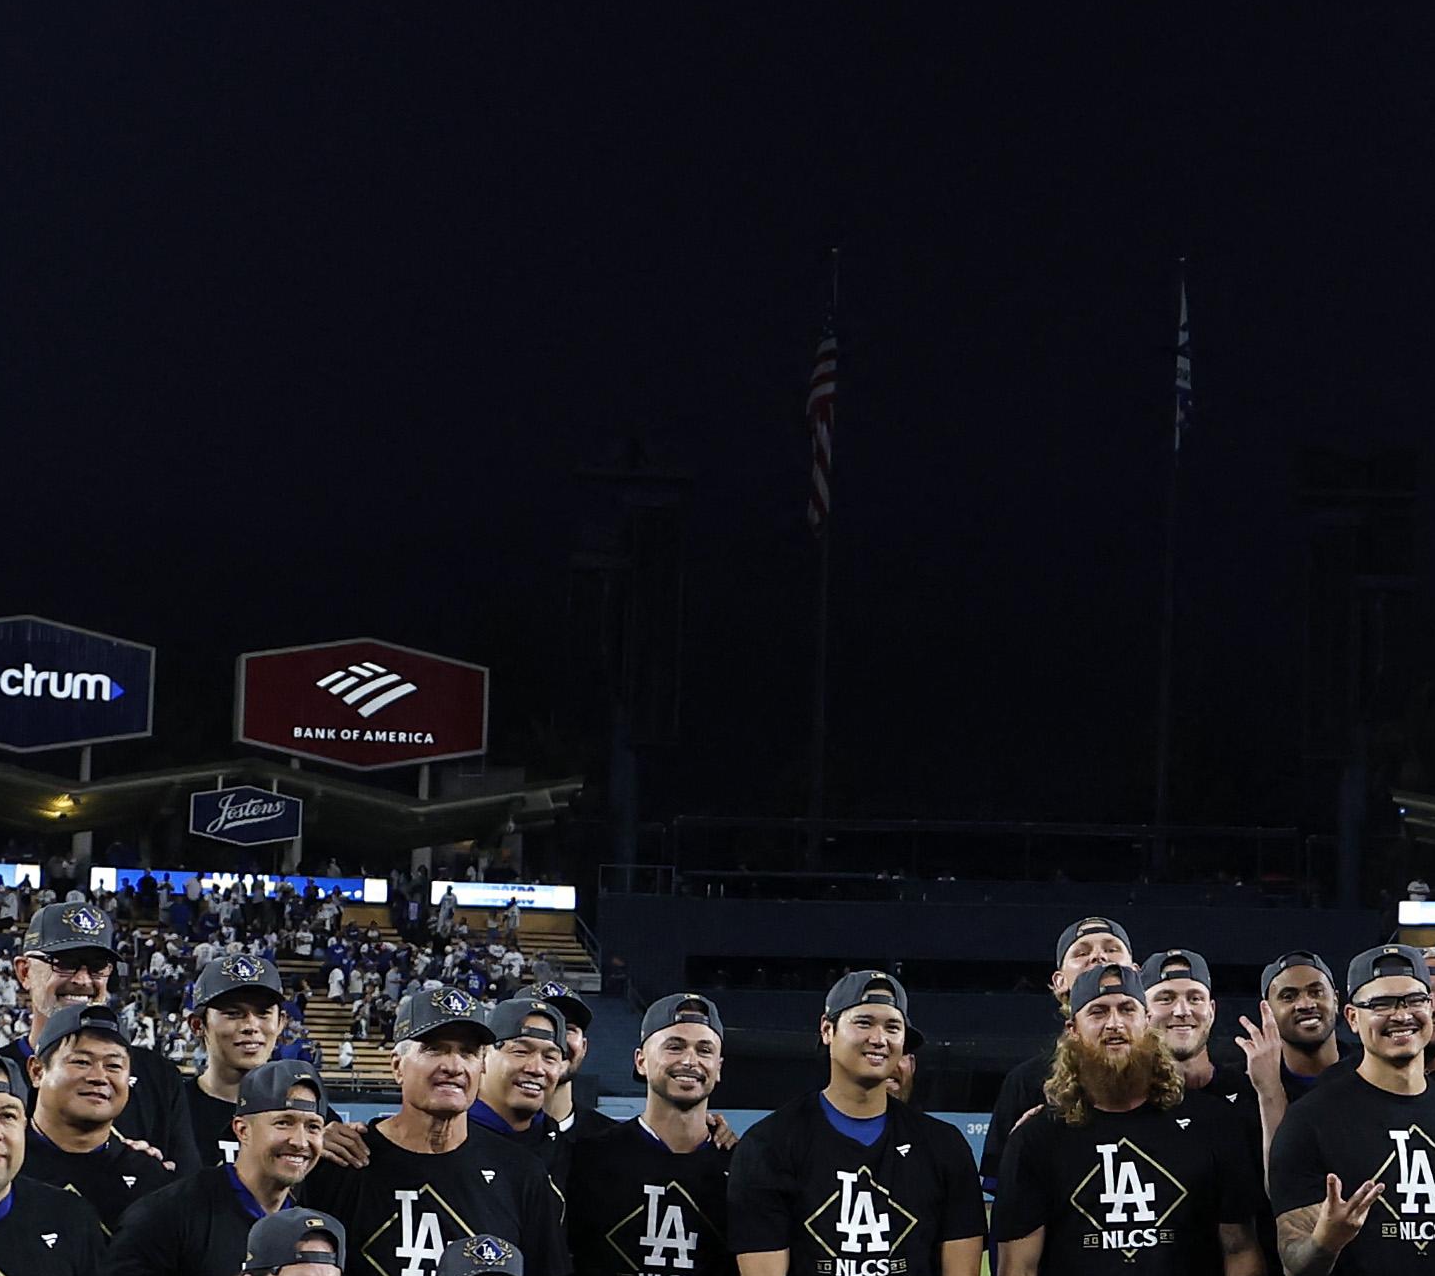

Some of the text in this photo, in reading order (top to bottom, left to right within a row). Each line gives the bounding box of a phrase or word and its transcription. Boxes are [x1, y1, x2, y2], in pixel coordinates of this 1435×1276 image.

[294, 727, 433, 743] BANK OF AMERICA
[206, 792, 286, 833] Jostens
[967, 1122, 990, 1136] 395
[1096, 1143, 1156, 1222] LA
[639, 1184, 698, 1268] LA
[836, 1170, 890, 1252] LA
[1102, 1229, 1157, 1249] NLCS
[836, 1258, 889, 1276] NLCS
